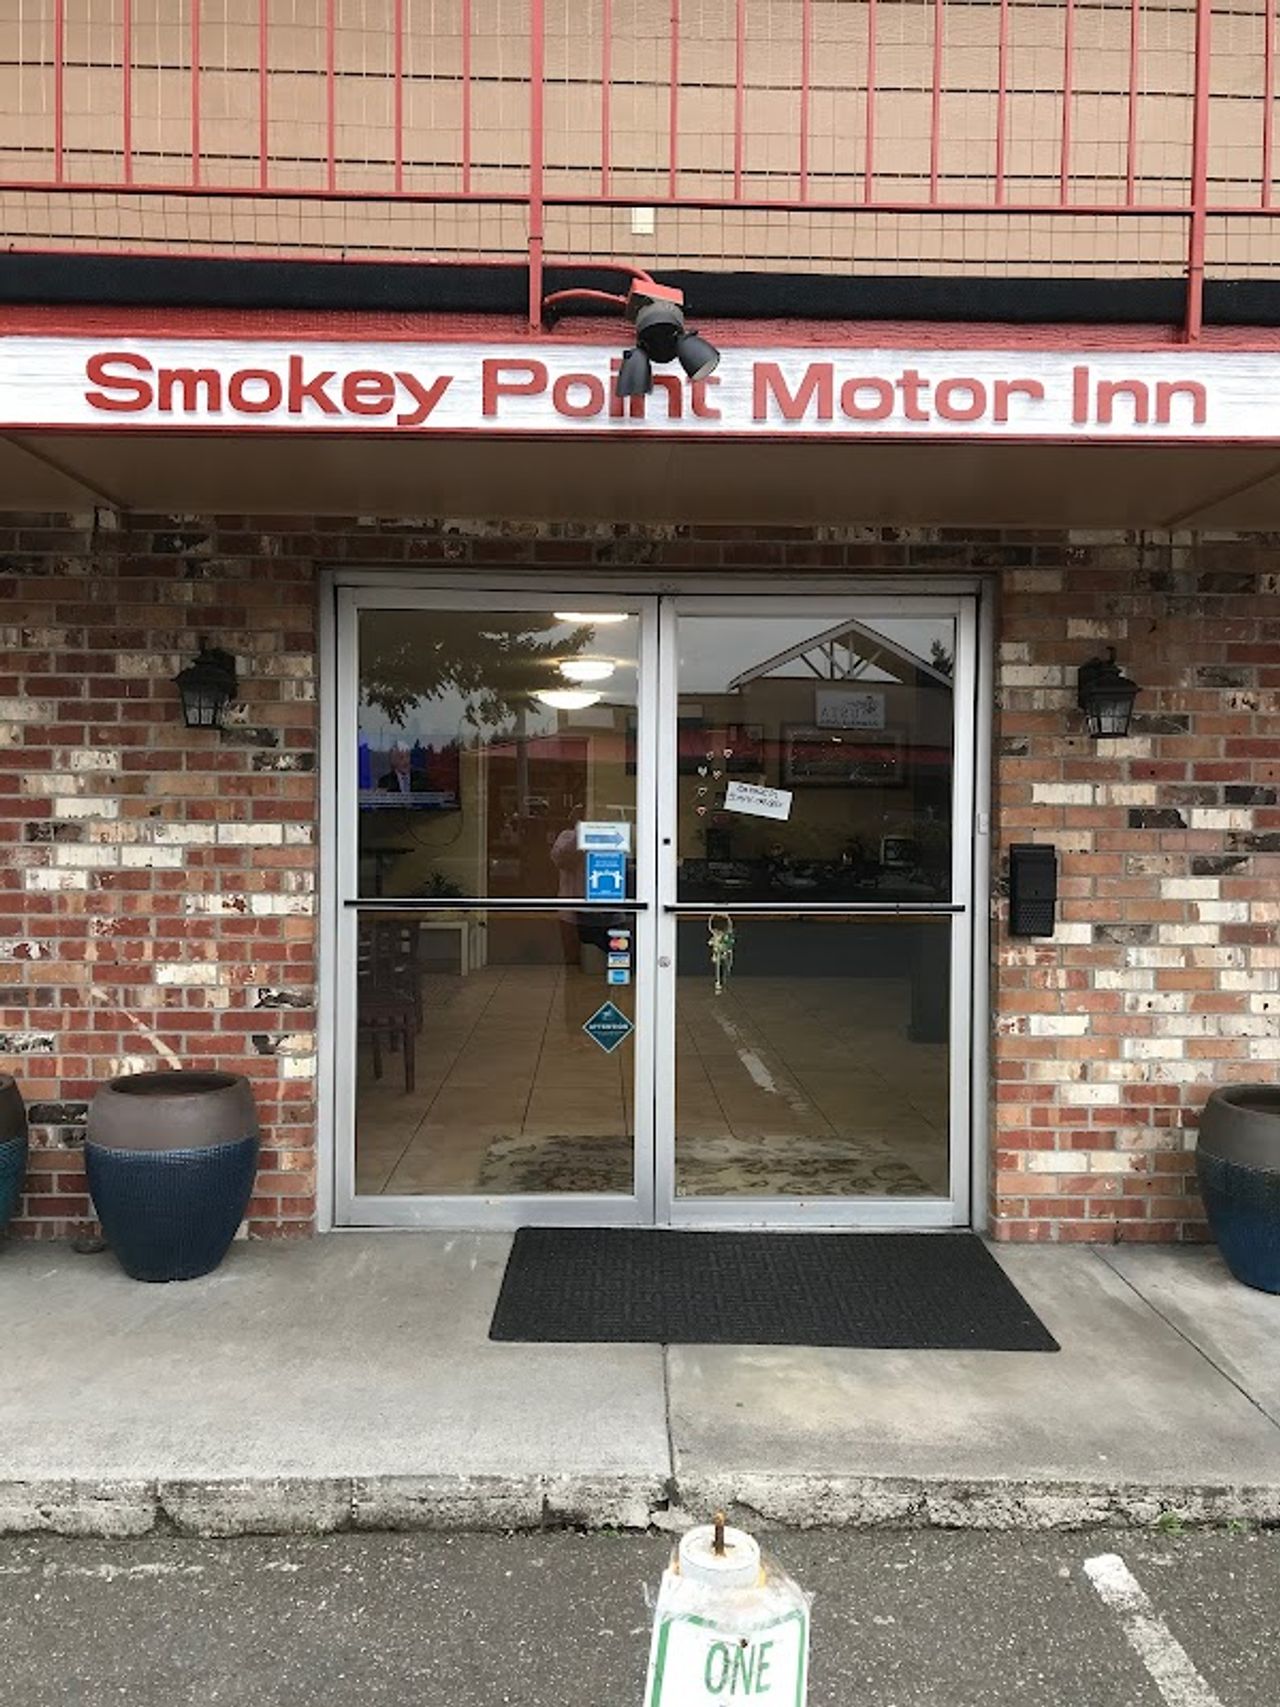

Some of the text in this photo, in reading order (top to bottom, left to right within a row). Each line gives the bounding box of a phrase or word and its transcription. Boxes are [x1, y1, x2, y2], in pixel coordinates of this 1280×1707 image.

[85, 352, 1207, 425] Smokey Point Motor Inn
[705, 1640, 773, 1695] ONE
